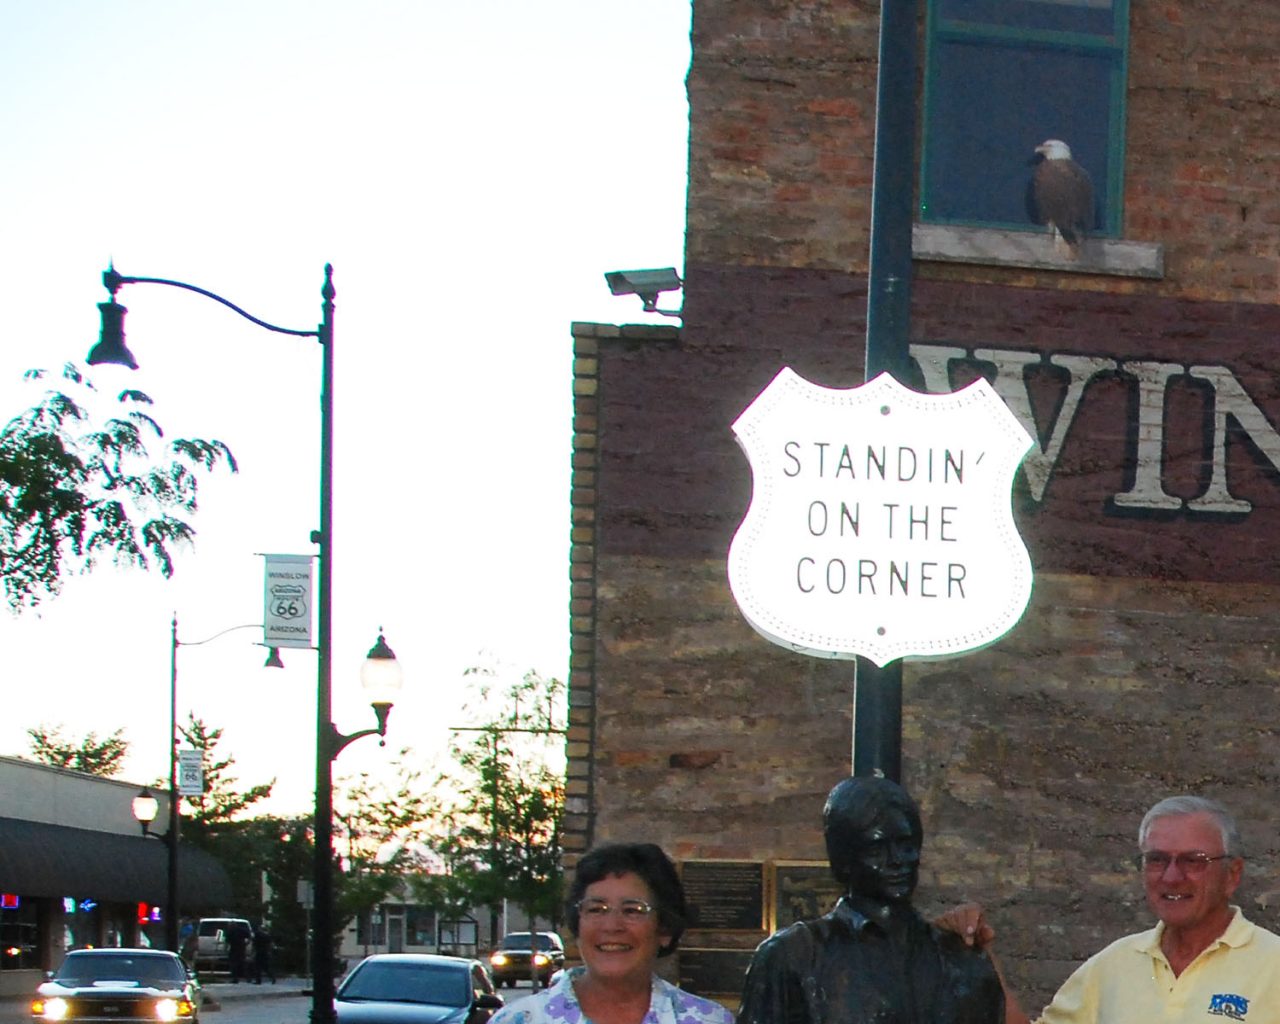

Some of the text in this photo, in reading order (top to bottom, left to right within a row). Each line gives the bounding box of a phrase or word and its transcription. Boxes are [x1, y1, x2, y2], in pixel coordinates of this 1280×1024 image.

[783, 441, 985, 484] STANDIN'
[807, 500, 958, 542] ON THE
[268, 572, 309, 580] WINSLOW
[796, 556, 967, 600] CORNER
[276, 601, 298, 616] 66
[269, 625, 308, 634] ARIZONA
